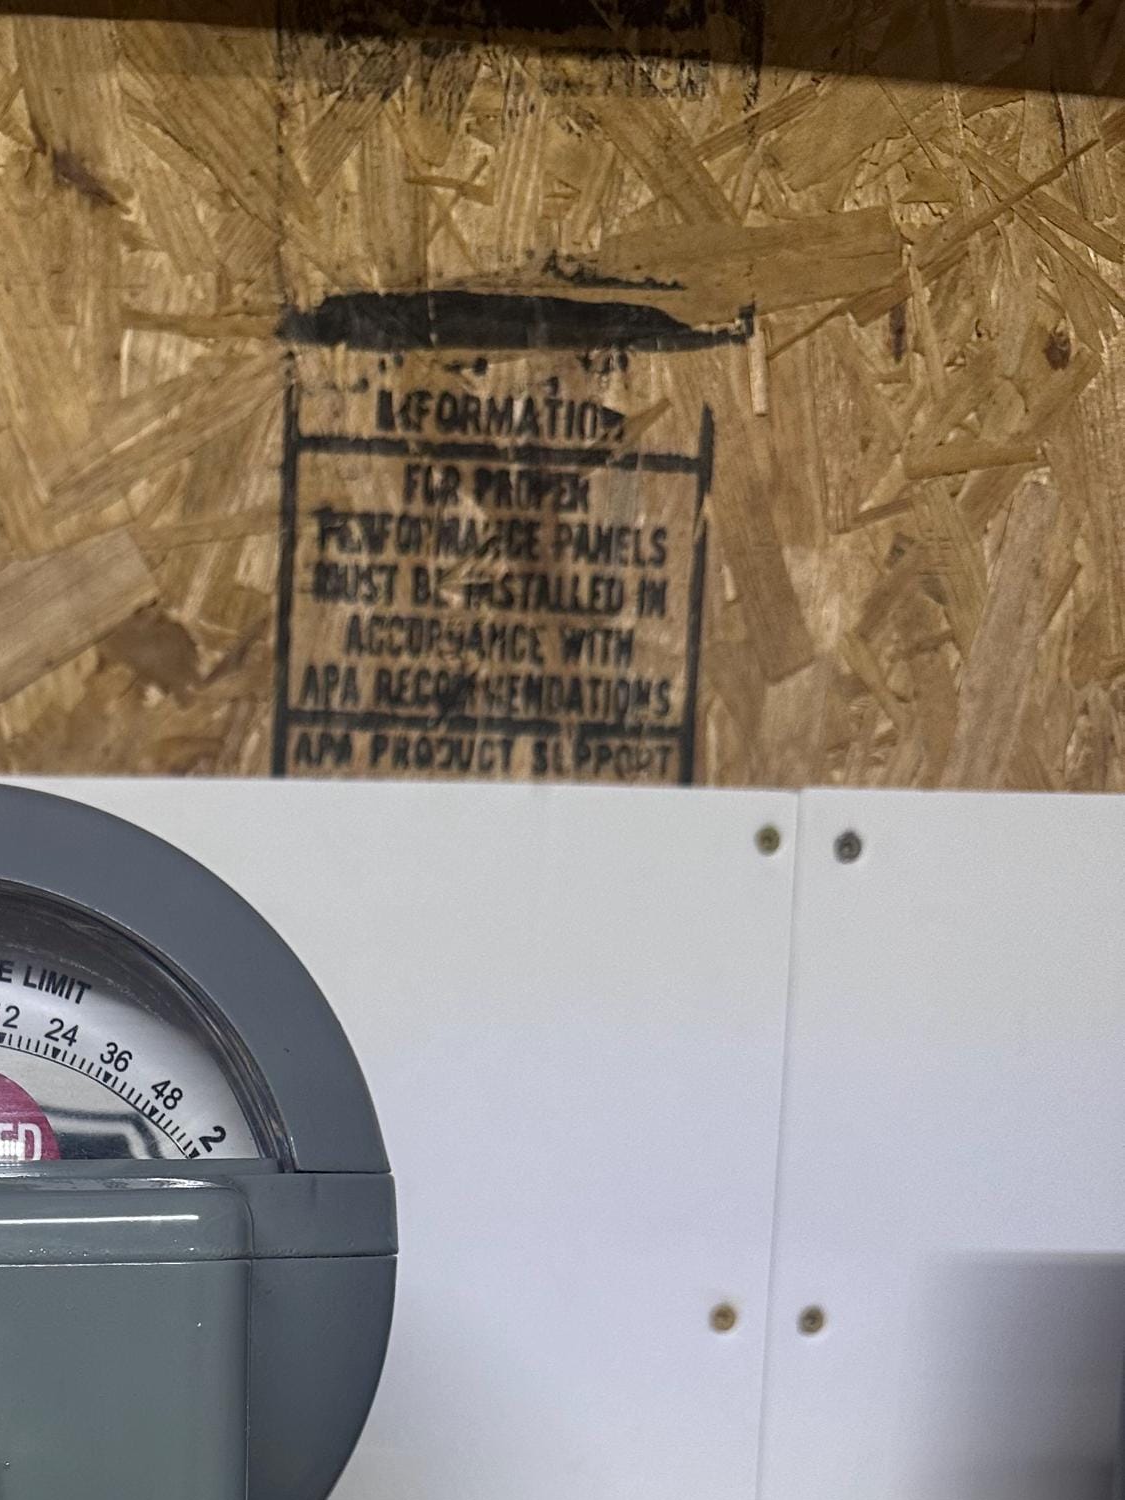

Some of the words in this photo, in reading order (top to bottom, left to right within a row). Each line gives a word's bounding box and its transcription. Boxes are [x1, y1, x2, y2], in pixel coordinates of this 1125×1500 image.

[554, 523, 668, 567] PANELS
[313, 561, 397, 606] MUST
[637, 577, 668, 617] IN
[562, 627, 634, 666] WITH
[301, 665, 359, 705] APA
[295, 733, 354, 766] APA
[370, 733, 512, 772] PRODUCT
[23, 966, 91, 1005] LIMIT
[44, 1018, 80, 1047] 24
[99, 1042, 132, 1073] 36
[150, 1079, 183, 1112] 48
[199, 1125, 226, 1154] 2
